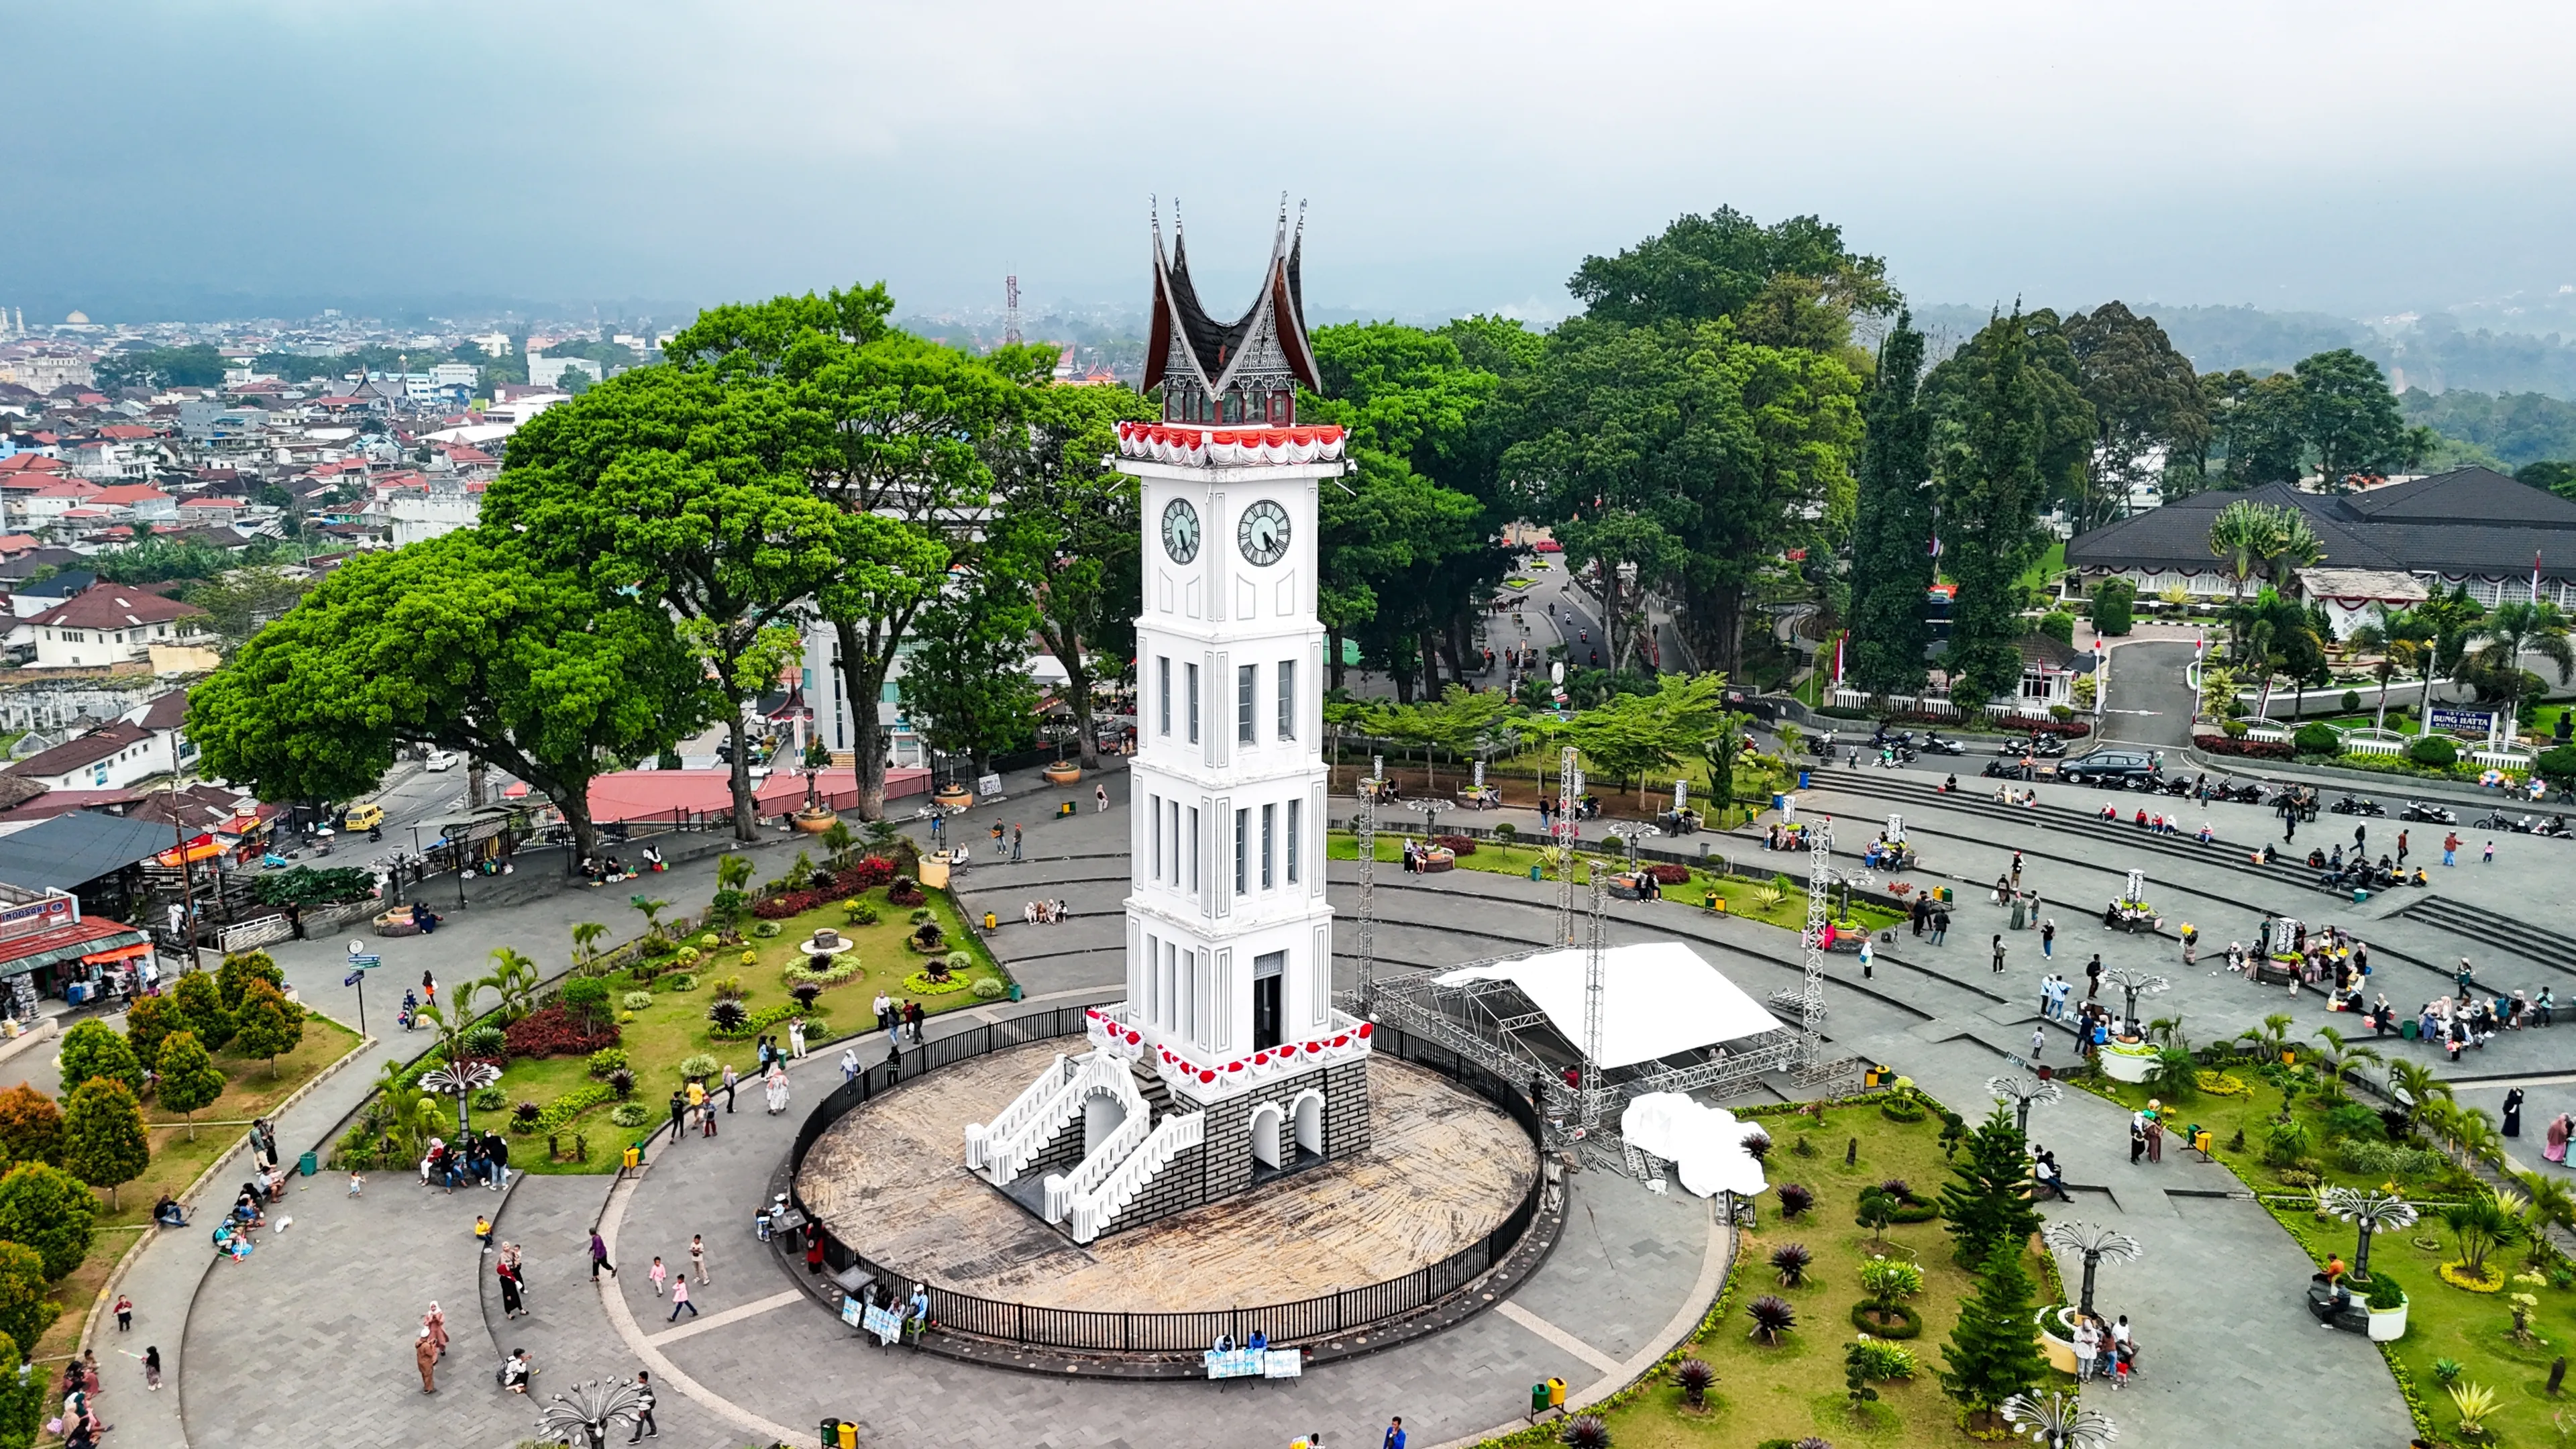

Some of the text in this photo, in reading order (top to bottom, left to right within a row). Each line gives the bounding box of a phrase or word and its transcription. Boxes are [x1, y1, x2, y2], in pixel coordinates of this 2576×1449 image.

[2433, 715, 2488, 726] BUNG HATTA
[2, 904, 46, 922] INDOSARI
